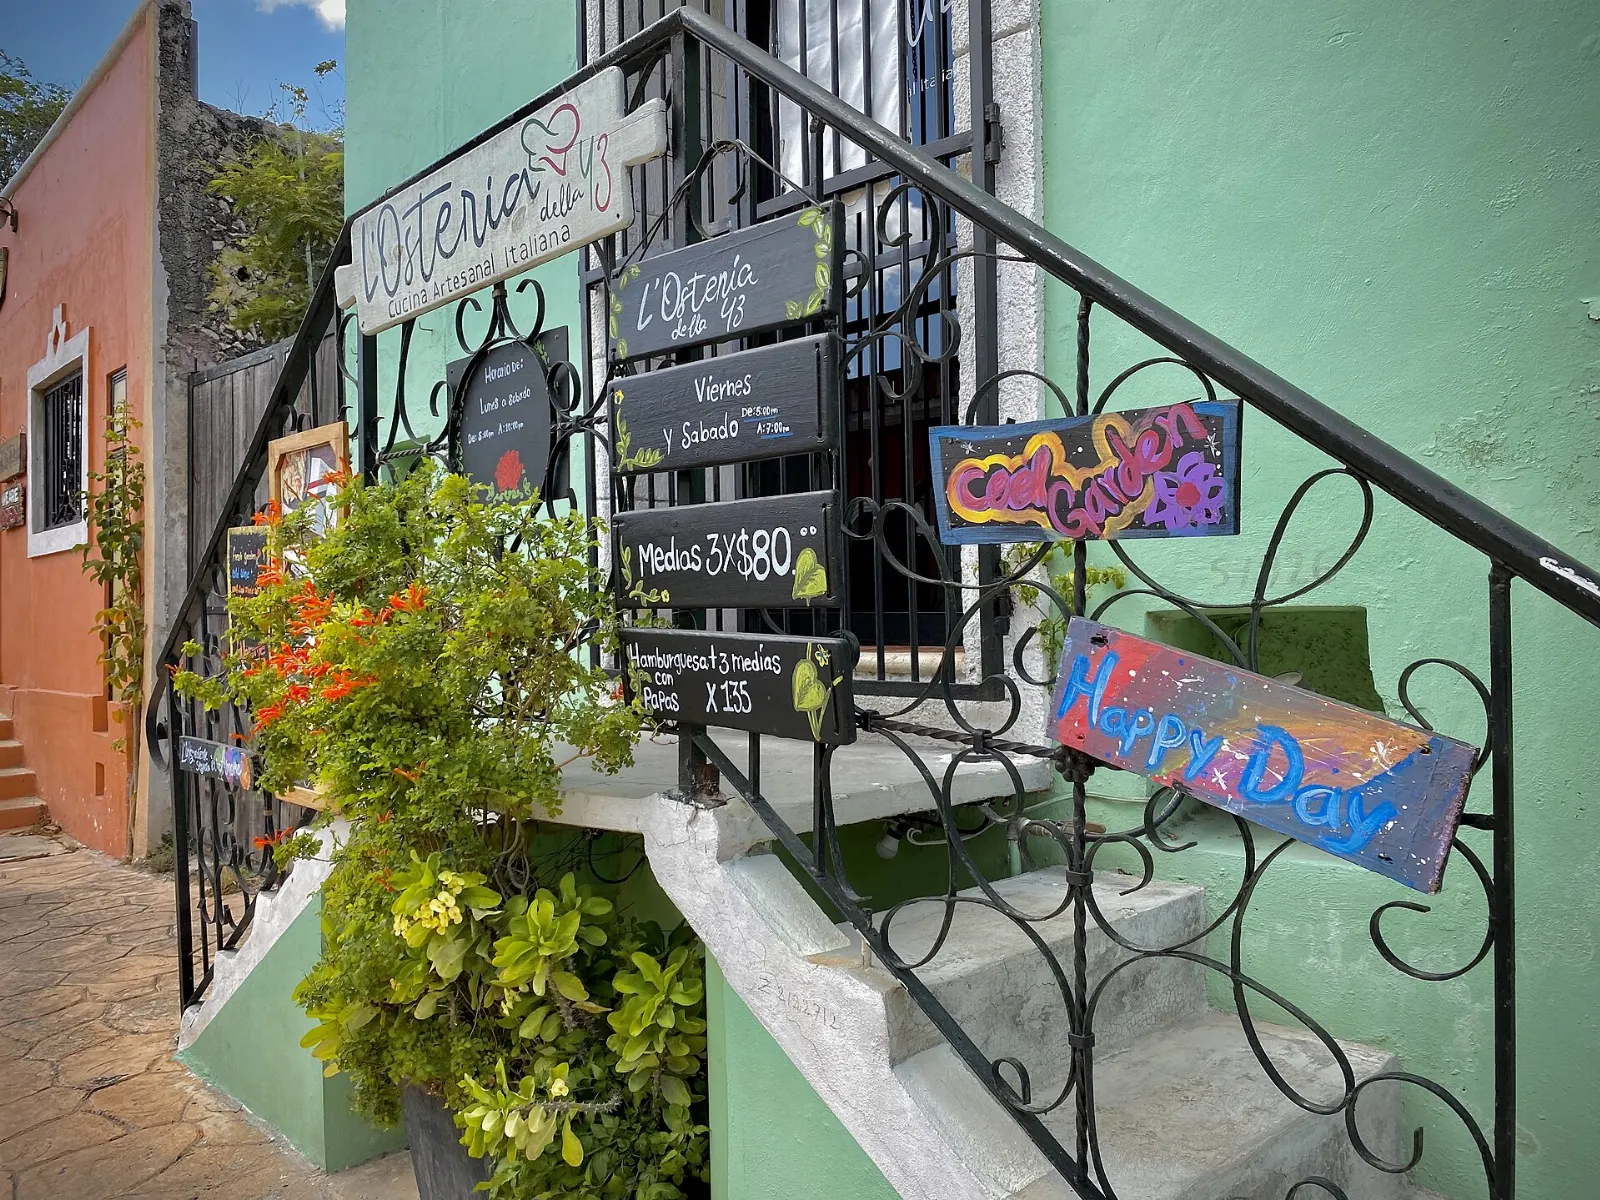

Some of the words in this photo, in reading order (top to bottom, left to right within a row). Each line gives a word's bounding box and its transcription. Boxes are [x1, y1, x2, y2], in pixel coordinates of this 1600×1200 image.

[540, 182, 584, 222] della
[388, 287, 428, 319] Cucina
[433, 251, 495, 299] Artesanal
[504, 224, 571, 269] Italiana
[671, 313, 708, 340] della
[484, 362, 511, 384] Horario
[694, 373, 752, 403] Viernes
[479, 397, 499, 415] Lunes
[501, 399, 507, 408] a
[681, 411, 739, 450] Sabado
[638, 535, 701, 578] Medias
[654, 671, 674, 687] con
[1057, 650, 1226, 782] Happy
[1238, 723, 1398, 854] Day
